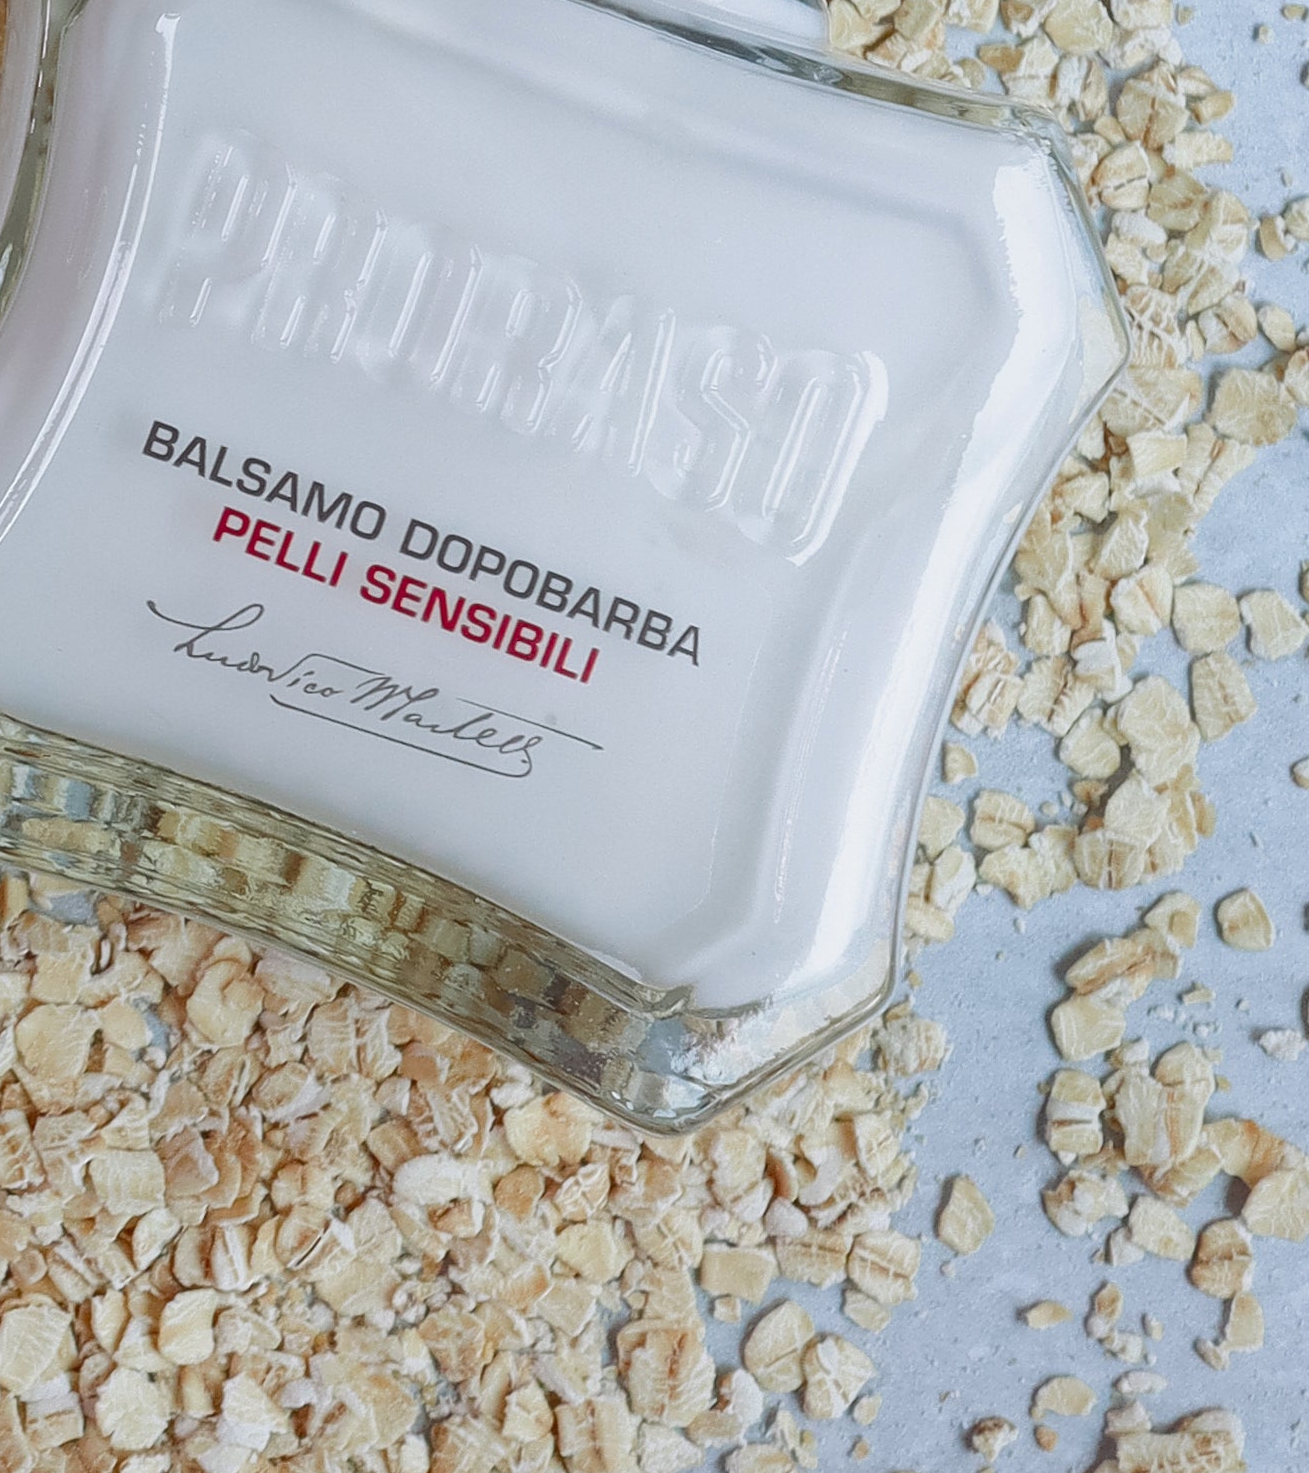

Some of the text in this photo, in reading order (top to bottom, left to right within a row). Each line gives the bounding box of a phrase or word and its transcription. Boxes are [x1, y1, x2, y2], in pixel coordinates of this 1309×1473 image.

[159, 126, 889, 566] PRORASO
[142, 420, 699, 666] BALSAMO DOPOBARBA
[212, 506, 599, 683] PELLI SENSIBILI
